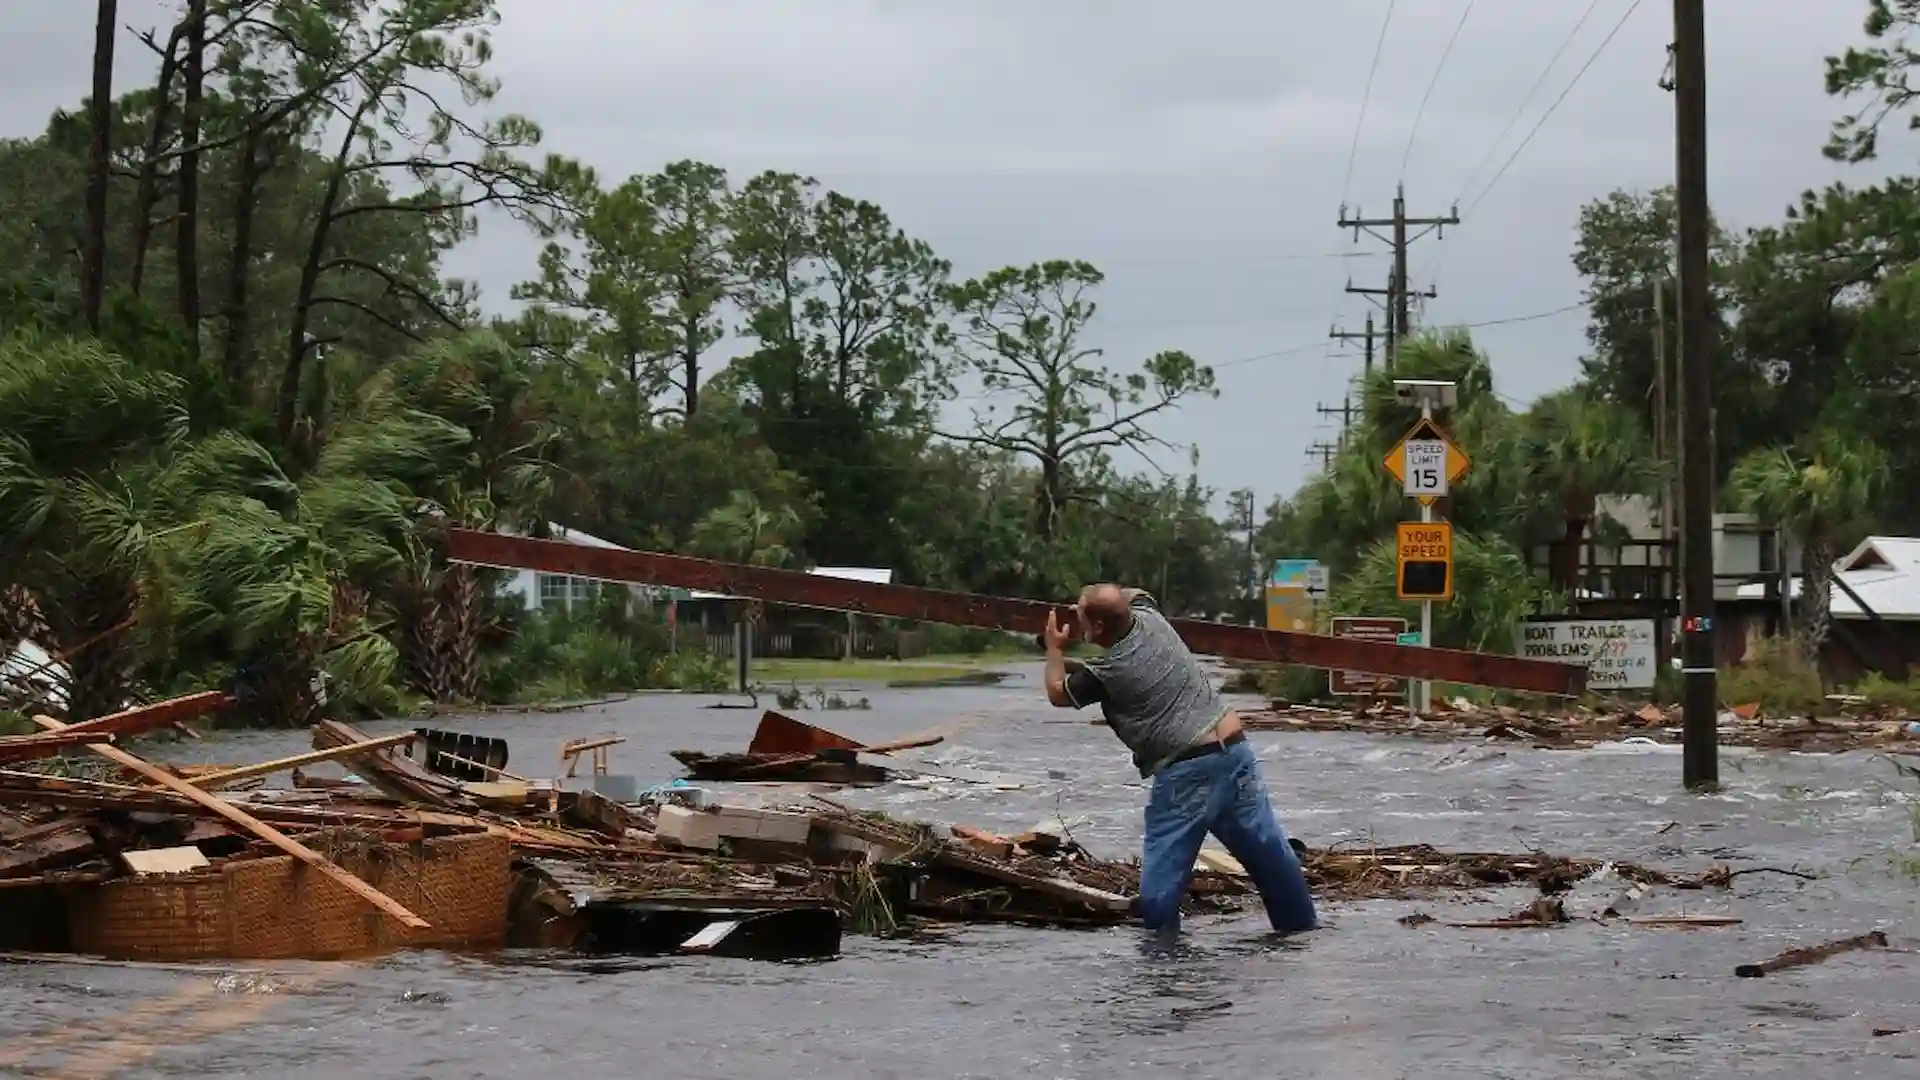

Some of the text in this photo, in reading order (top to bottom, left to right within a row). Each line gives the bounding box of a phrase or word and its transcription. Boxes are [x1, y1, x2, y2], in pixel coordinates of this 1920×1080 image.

[1407, 445, 1444, 454] SPEED
[1411, 455, 1440, 465] LIMIT
[1413, 469, 1437, 488] 15
[1406, 530, 1442, 543] YOUR
[1402, 544, 1447, 557] SPEED
[1524, 626, 1556, 640] BOAT
[1569, 624, 1627, 639] TRAILER
[1524, 643, 1589, 657] PROBLEMS
